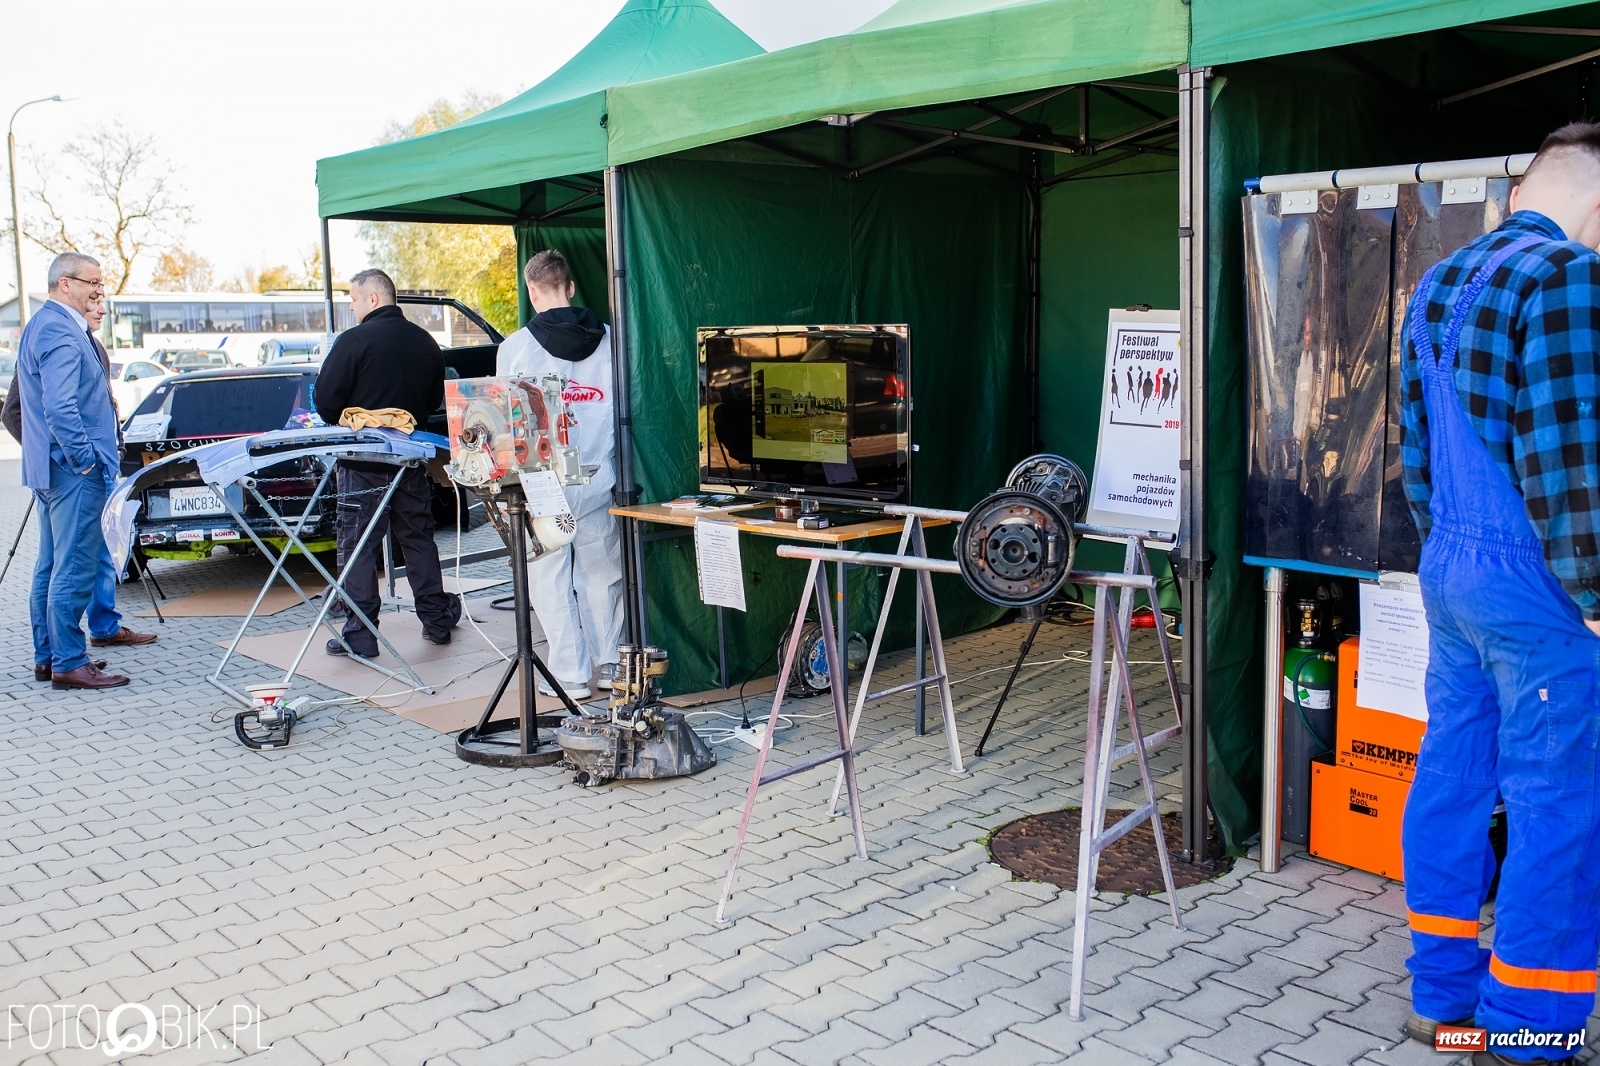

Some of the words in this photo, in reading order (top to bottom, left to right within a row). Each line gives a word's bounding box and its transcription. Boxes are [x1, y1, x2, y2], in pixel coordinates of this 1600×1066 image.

[1121, 334, 1160, 347] Festiwal
[1119, 348, 1174, 362] perspektyw
[1164, 419, 1180, 429] 2019
[1132, 472, 1177, 485] mechanika
[1136, 484, 1176, 496] pojazdów
[173, 496, 221, 512] 4WNC834
[1107, 492, 1174, 509] samochodowych
[1373, 602, 1399, 611] Prezentacja
[1389, 762, 1416, 772] Weldin
